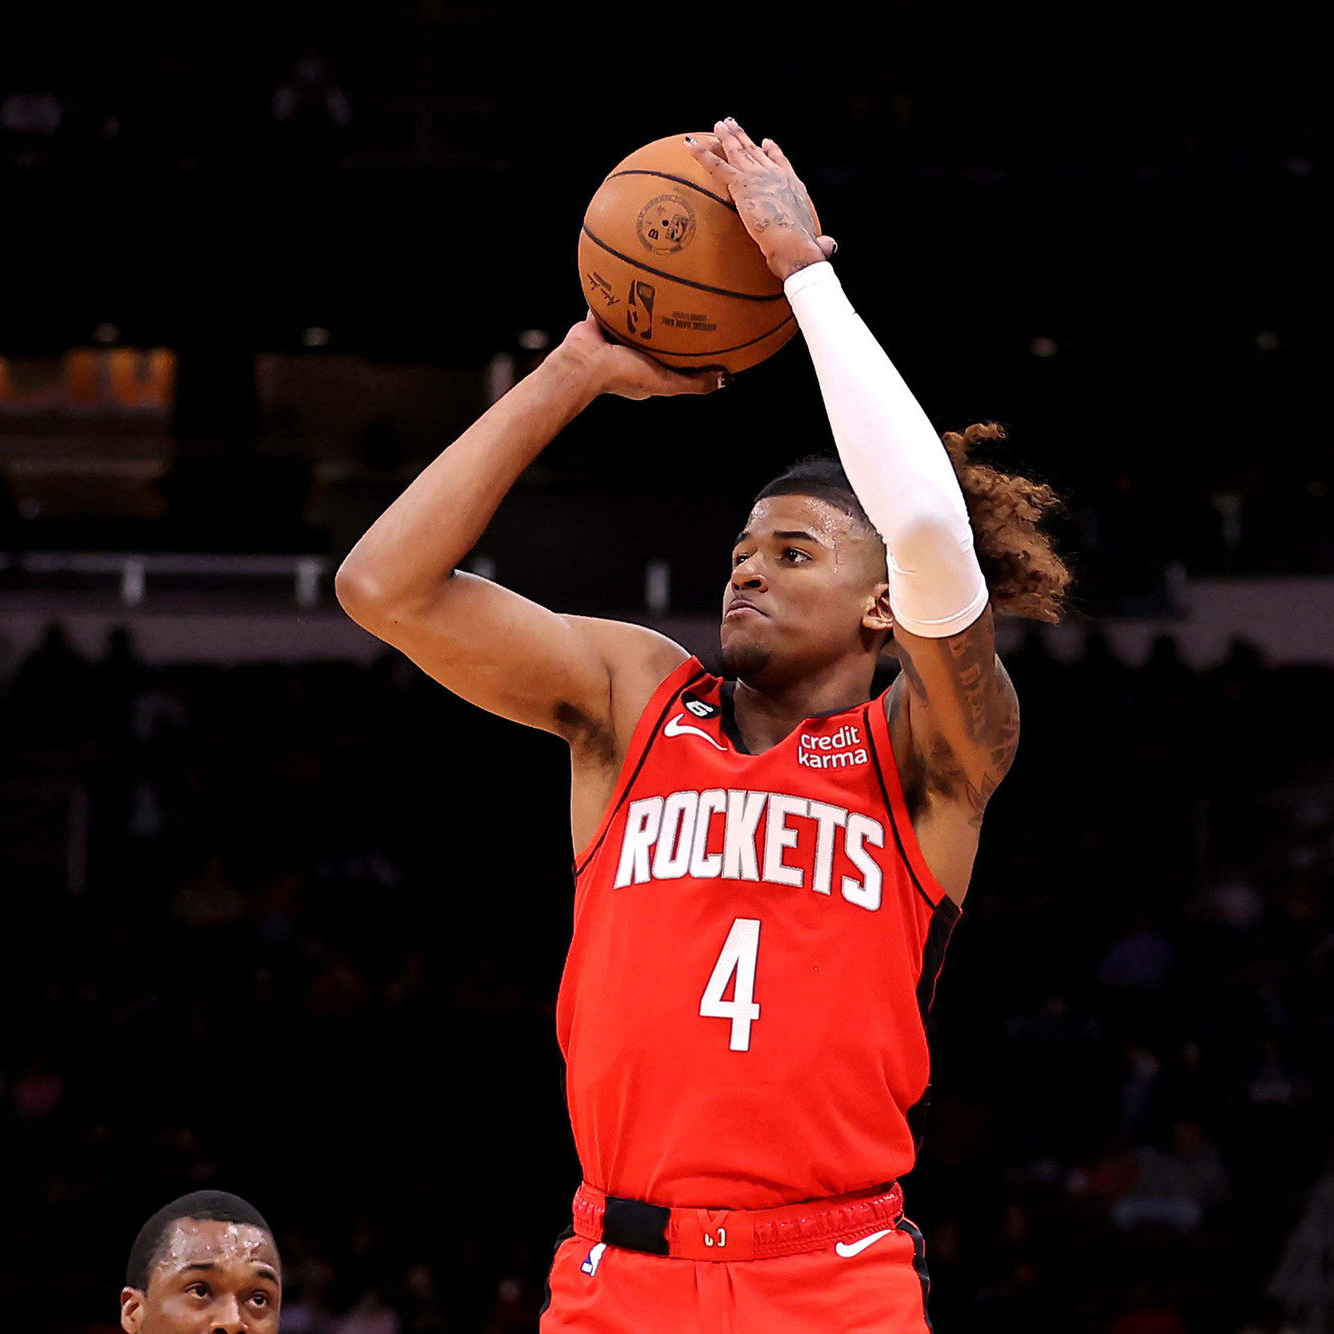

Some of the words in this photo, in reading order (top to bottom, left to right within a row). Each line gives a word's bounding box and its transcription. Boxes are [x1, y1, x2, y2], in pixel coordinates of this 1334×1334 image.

[797, 745, 869, 770] karma
[800, 725, 861, 750] credit
[613, 788, 886, 912] ROCKETS
[698, 917, 762, 1052] 4
